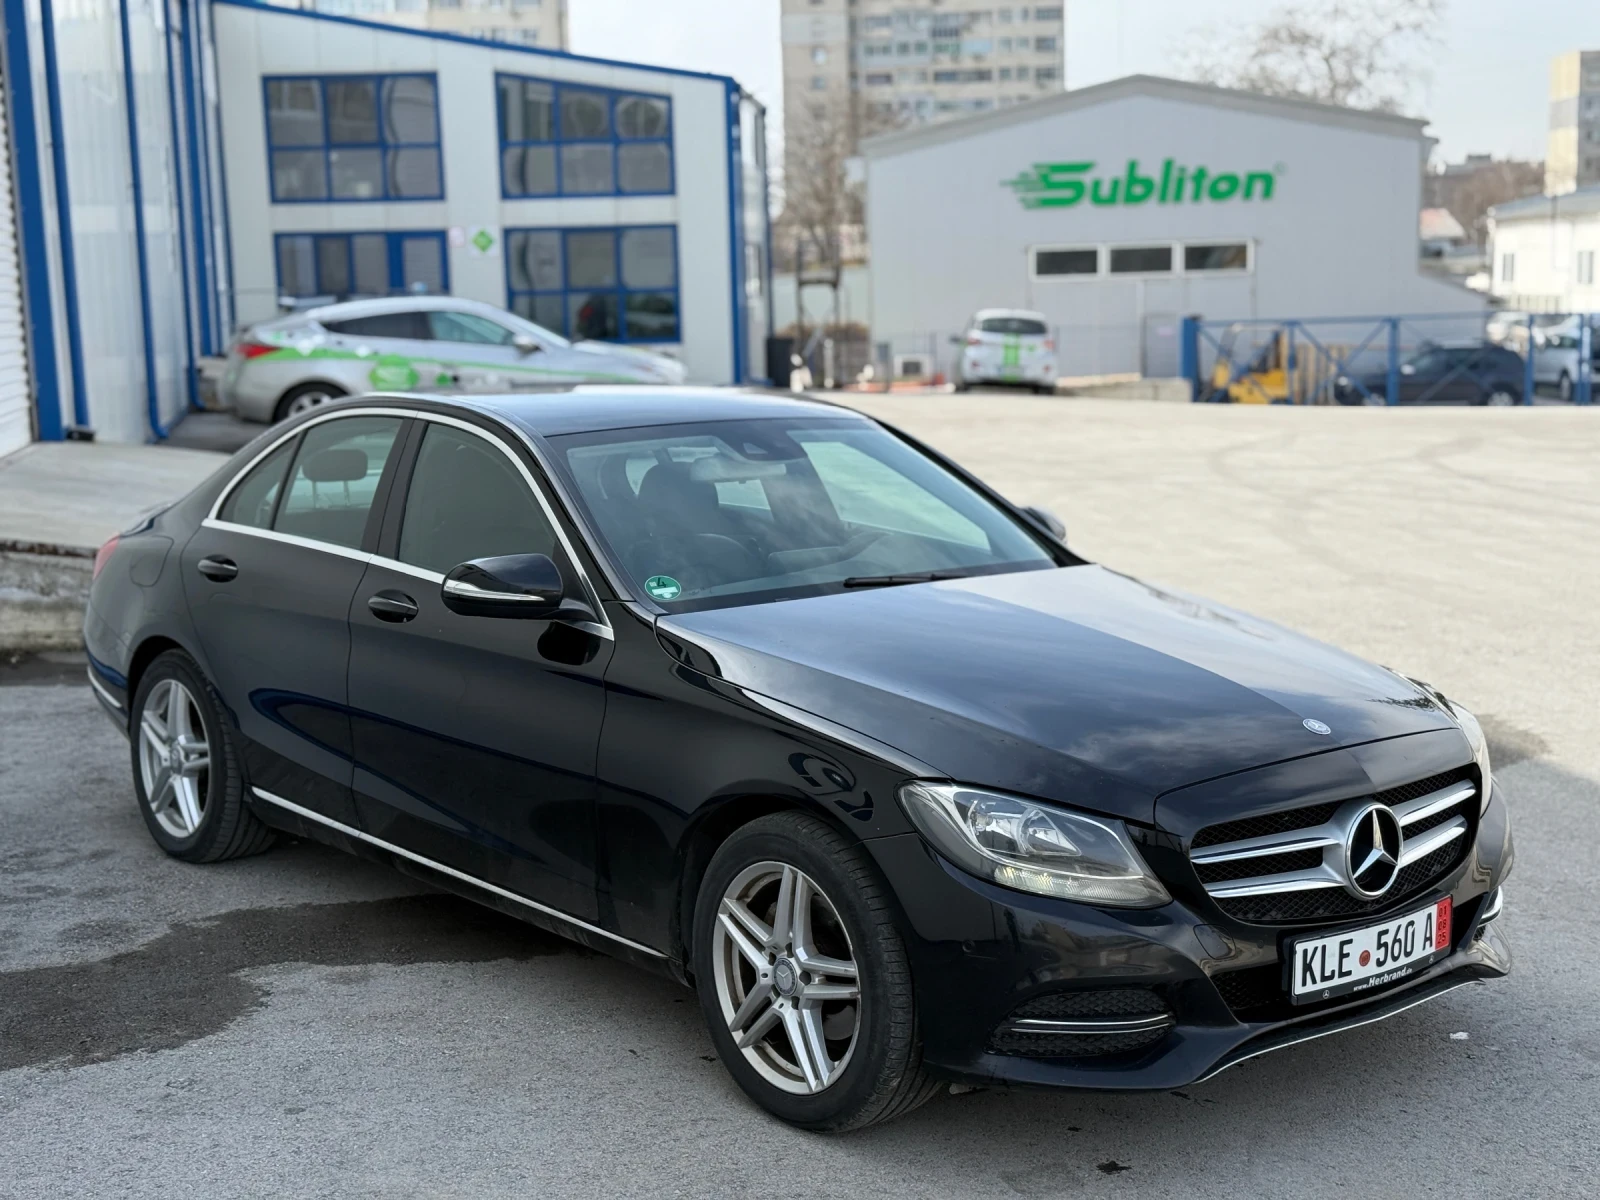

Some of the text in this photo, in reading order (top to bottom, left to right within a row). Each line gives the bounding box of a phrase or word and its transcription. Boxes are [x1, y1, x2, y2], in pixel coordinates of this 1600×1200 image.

[1000, 158, 1276, 210] Subliton
[1438, 905, 1447, 918] 01
[1438, 918, 1447, 931] 08
[1437, 931, 1446, 944] 25
[1301, 912, 1433, 988] KLE 560 A
